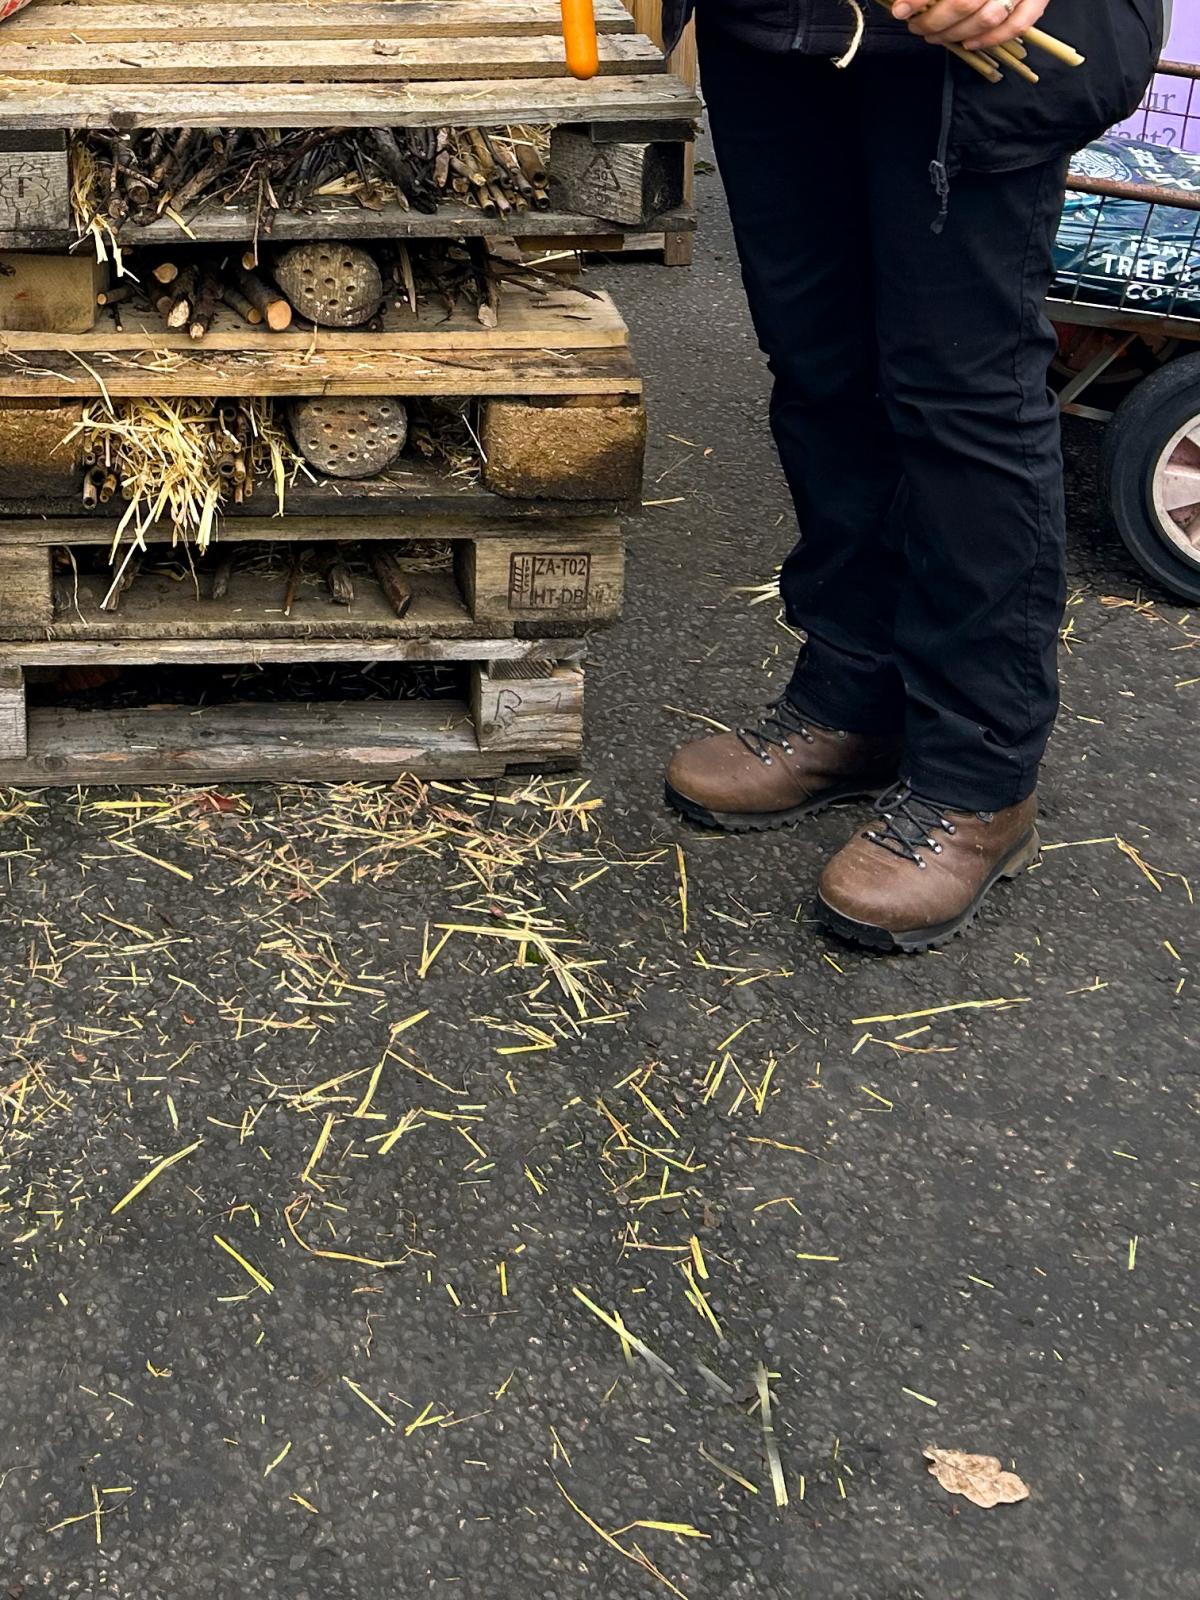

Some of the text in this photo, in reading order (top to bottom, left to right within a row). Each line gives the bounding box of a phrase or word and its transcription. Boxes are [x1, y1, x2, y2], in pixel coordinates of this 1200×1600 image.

[1102, 253, 1167, 280] TREE
[535, 558, 586, 576] ZA-T02
[534, 588, 584, 604] HT-DB
